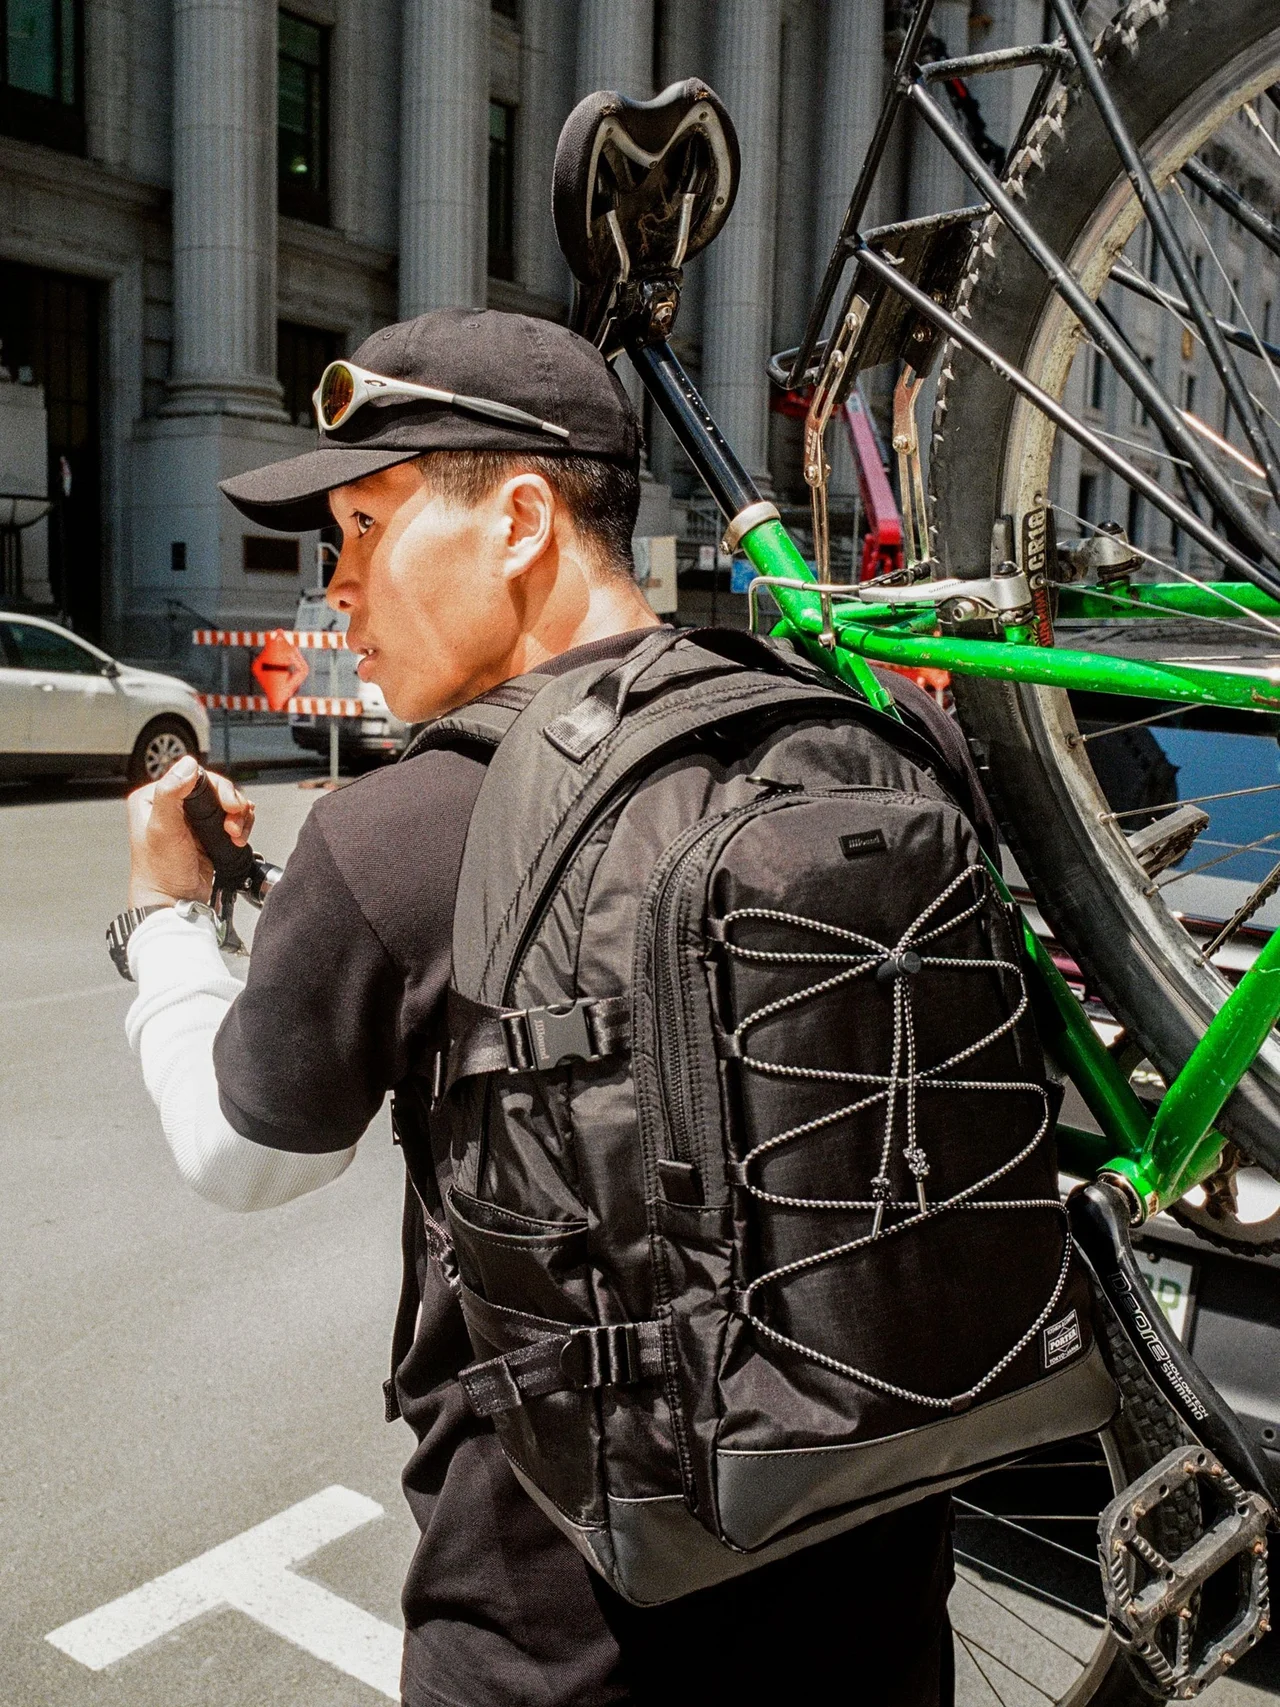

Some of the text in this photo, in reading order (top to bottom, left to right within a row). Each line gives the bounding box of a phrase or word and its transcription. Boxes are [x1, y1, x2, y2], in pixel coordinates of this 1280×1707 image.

[1028, 510, 1045, 572] CR18
[1050, 1328, 1077, 1350] PORTER
[1161, 1362, 1204, 1421] SHIMANO
[1167, 1359, 1209, 1418] HOLLOWTECH
